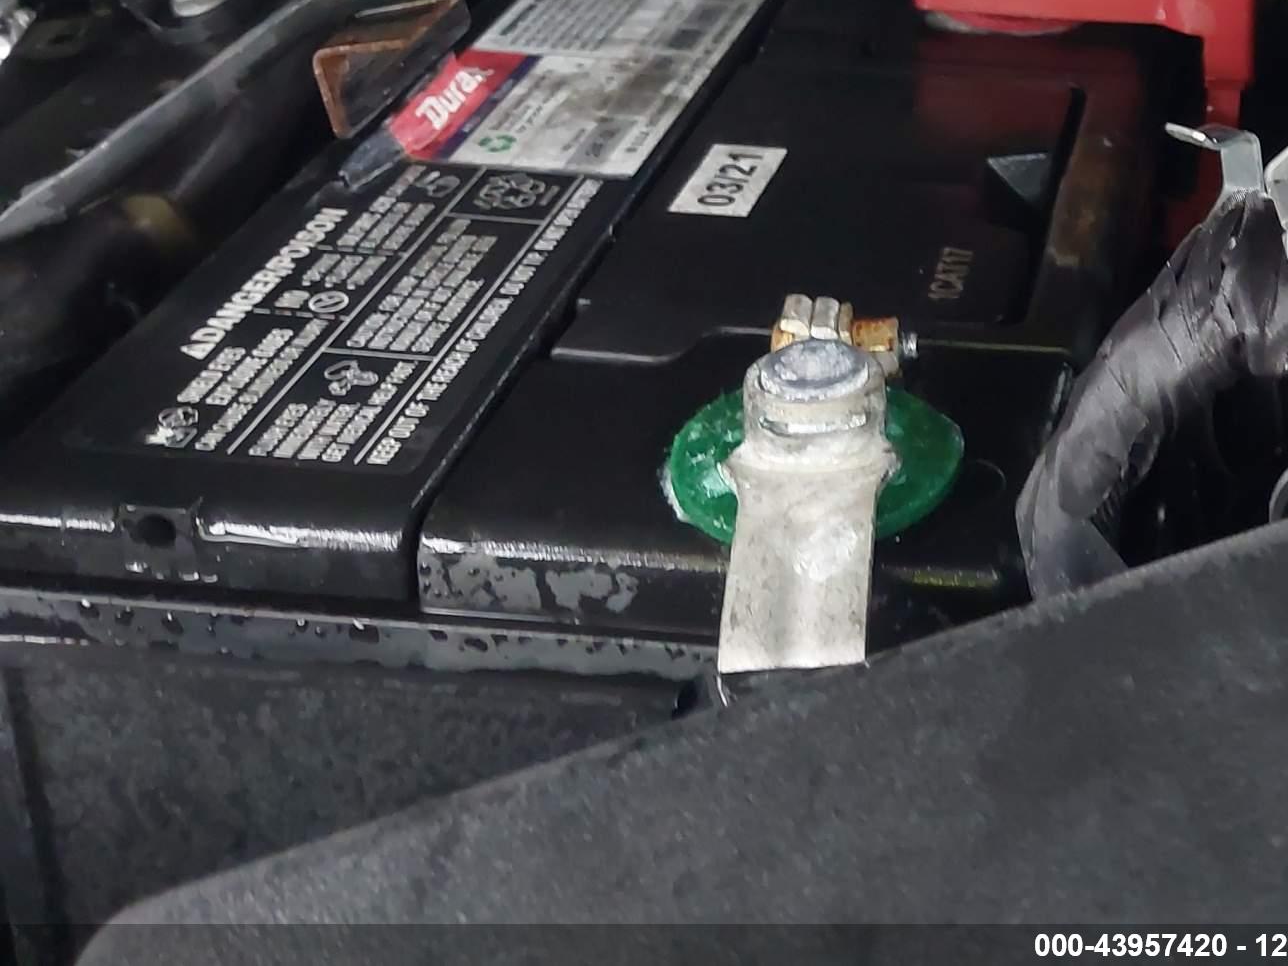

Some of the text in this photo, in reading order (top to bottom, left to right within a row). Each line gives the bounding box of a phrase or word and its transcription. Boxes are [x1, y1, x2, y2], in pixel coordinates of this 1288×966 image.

[697, 152, 763, 207] 03/21
[192, 208, 347, 342] DANGER/POISON
[367, 437, 400, 464] KEEP
[388, 416, 419, 438] OUT
